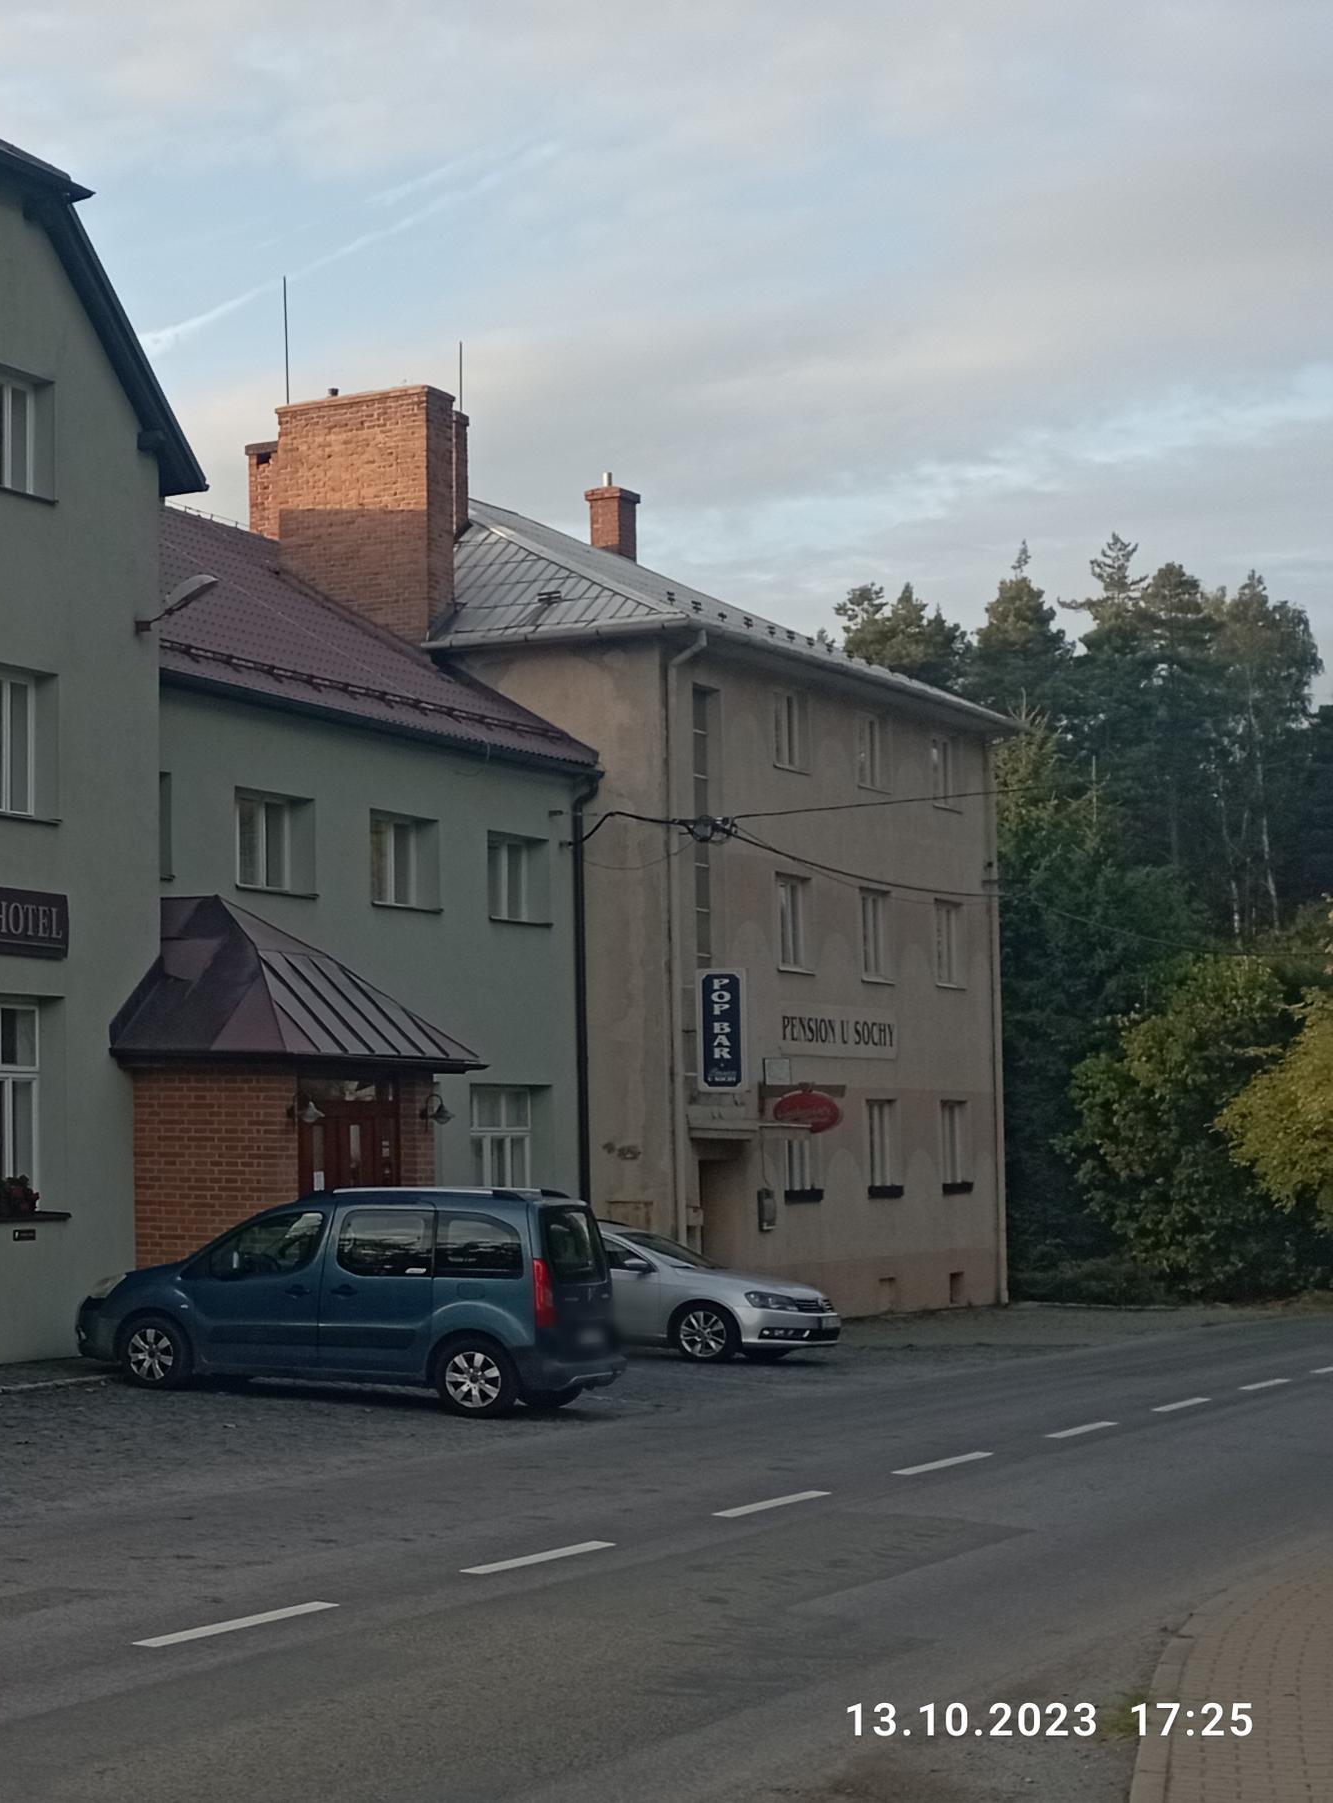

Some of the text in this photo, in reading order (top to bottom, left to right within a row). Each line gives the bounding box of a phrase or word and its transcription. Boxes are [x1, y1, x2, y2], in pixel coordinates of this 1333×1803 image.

[711, 978, 732, 1015] POP
[713, 1022, 732, 1059] BAR
[782, 1015, 895, 1047] PENSION U SOCHY
